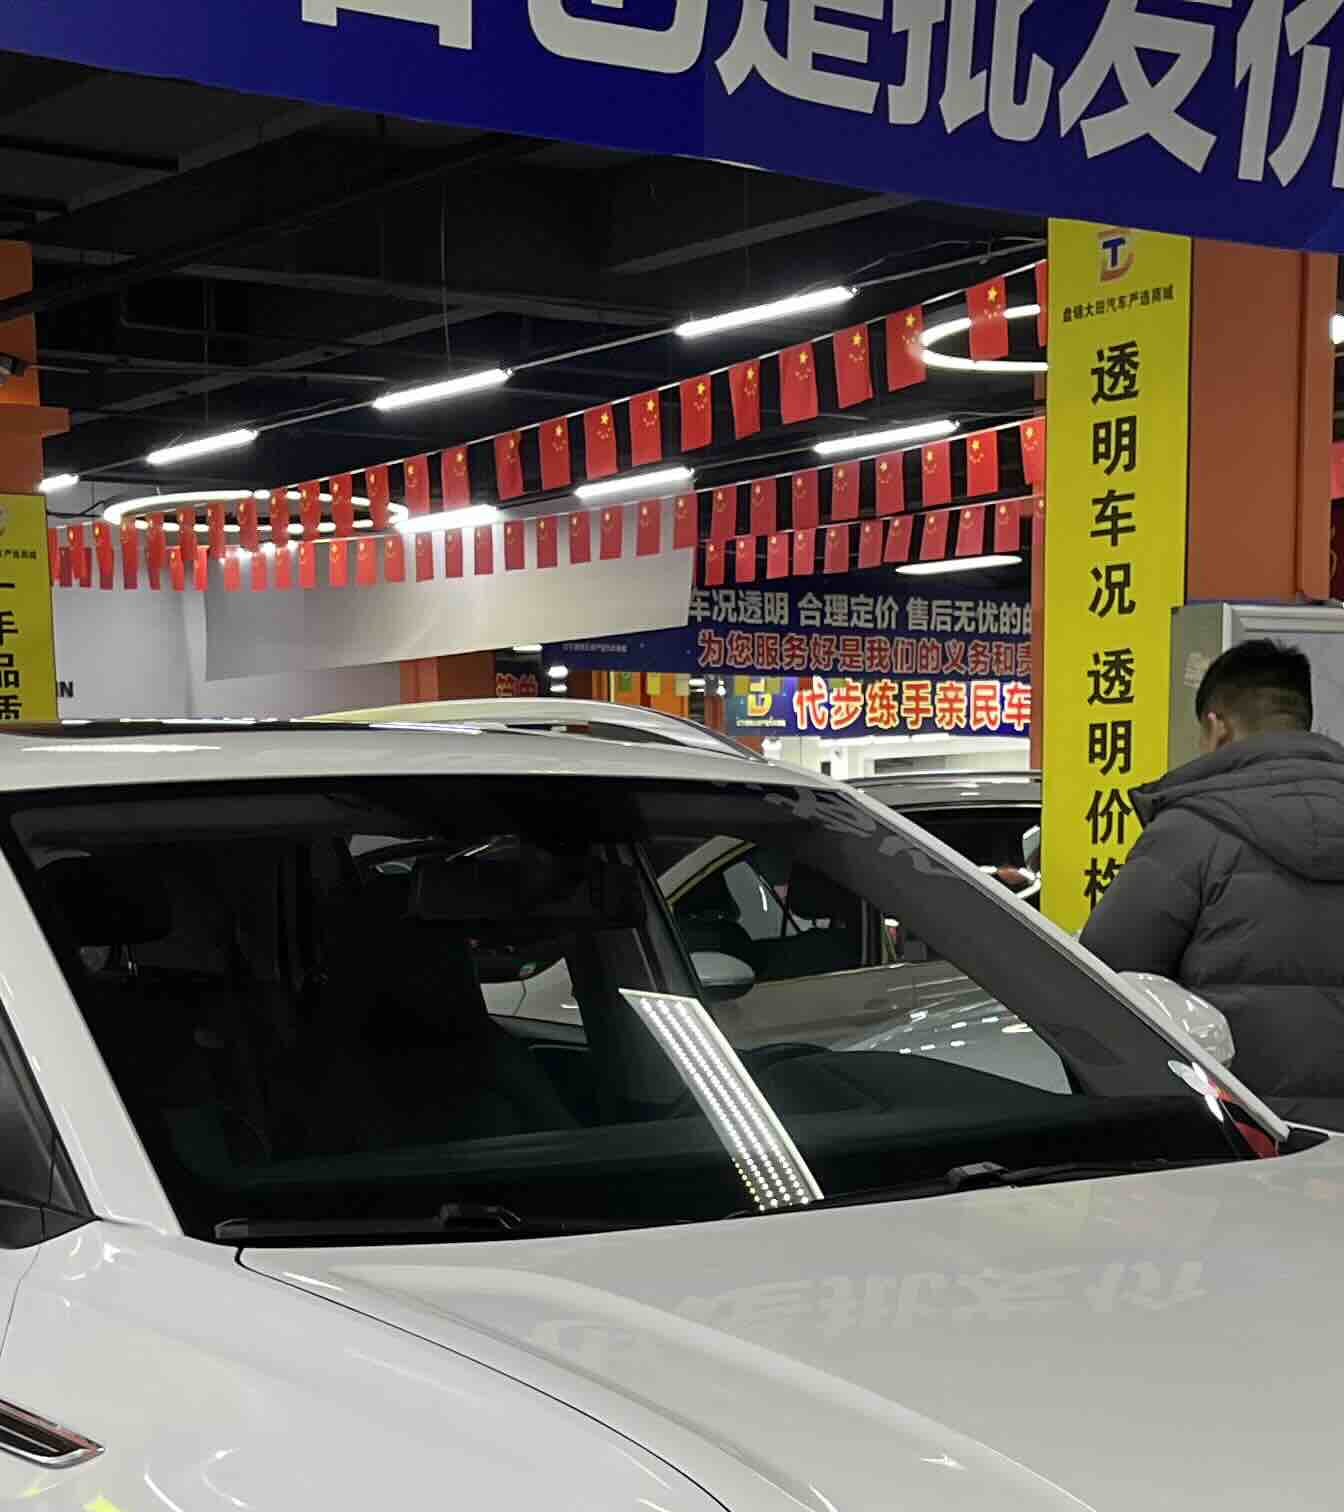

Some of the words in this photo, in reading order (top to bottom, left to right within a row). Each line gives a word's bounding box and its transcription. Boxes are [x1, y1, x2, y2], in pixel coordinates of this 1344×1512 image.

[1088, 340, 1139, 618] 透明车况
[797, 592, 899, 630] 合理定价
[792, 675, 1031, 731] 代步练手亲民车
